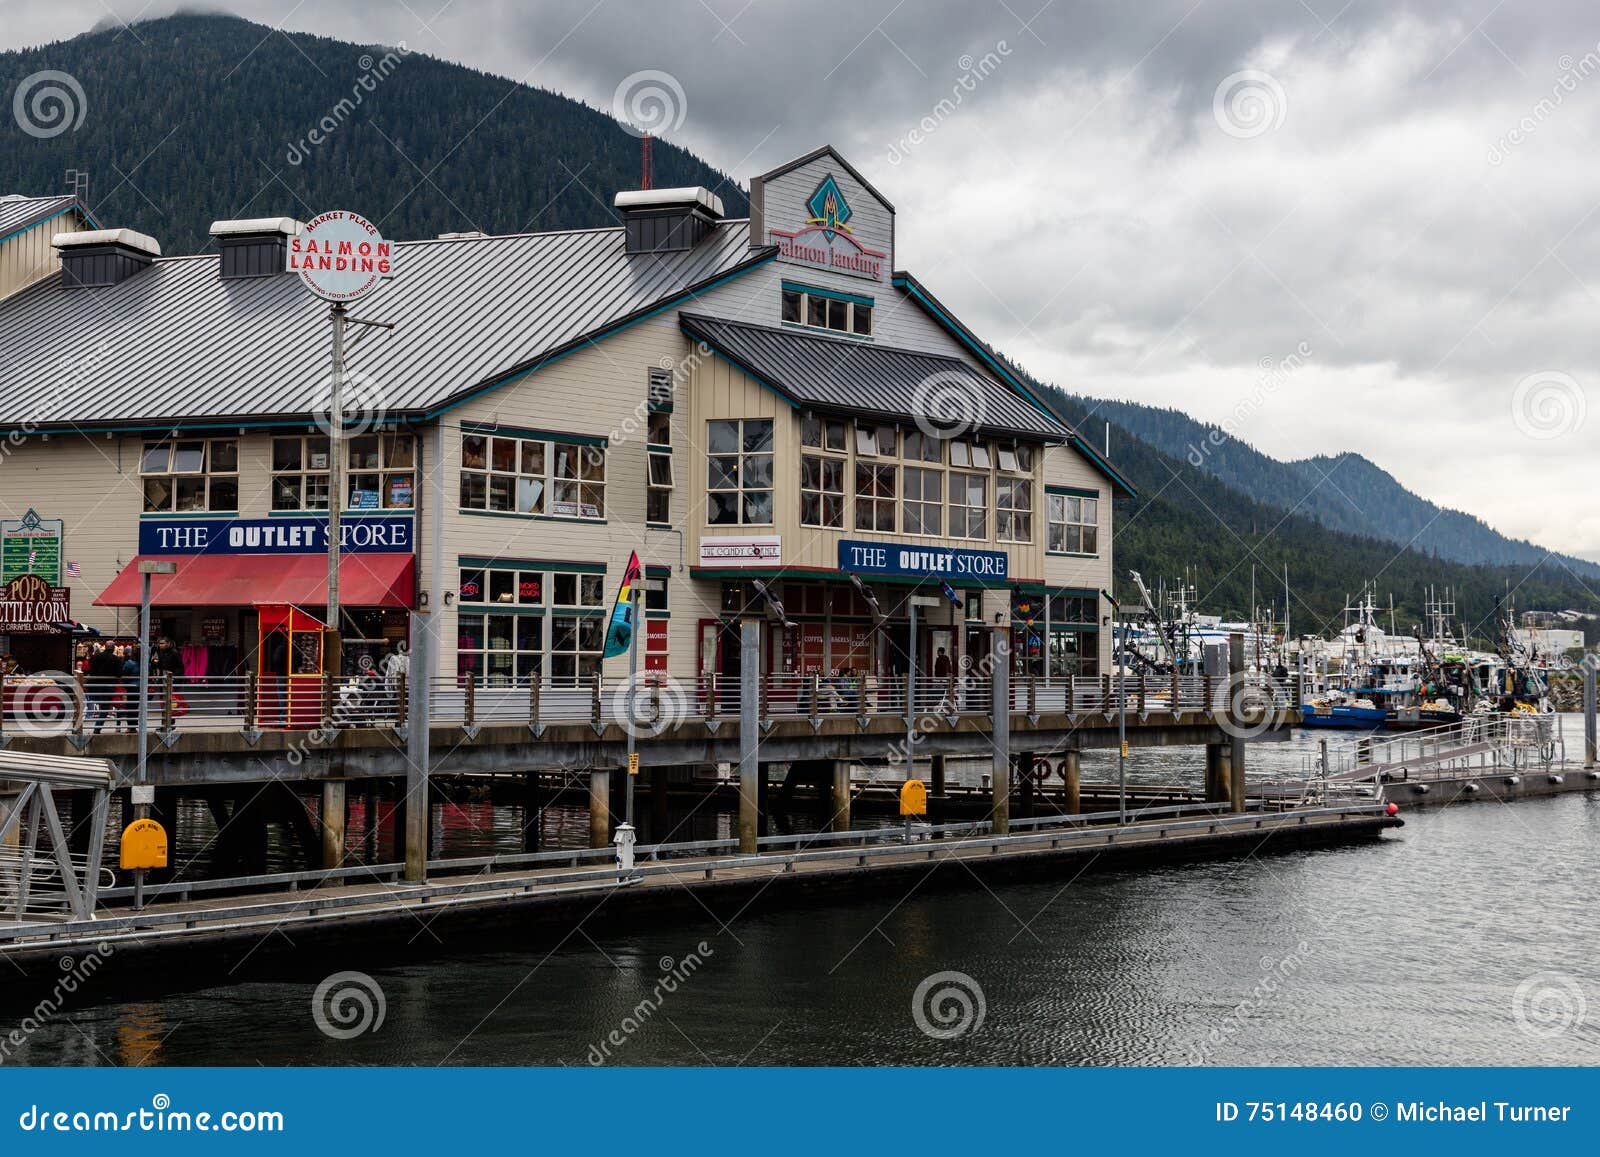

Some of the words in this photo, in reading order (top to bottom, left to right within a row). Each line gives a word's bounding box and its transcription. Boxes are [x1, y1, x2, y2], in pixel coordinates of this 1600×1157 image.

[306, 211, 344, 233] MARKET
[349, 213, 377, 236] PLACE
[291, 238, 390, 257] SALMON
[290, 255, 391, 274] LANDING
[156, 526, 209, 549] THE
[228, 525, 317, 548] OUTLET
[851, 547, 887, 568] THE
[899, 550, 953, 573] OUTLET
[957, 554, 1005, 575] STORE
[11, 576, 47, 601] POP'S
[35, 601, 69, 623] CORN
